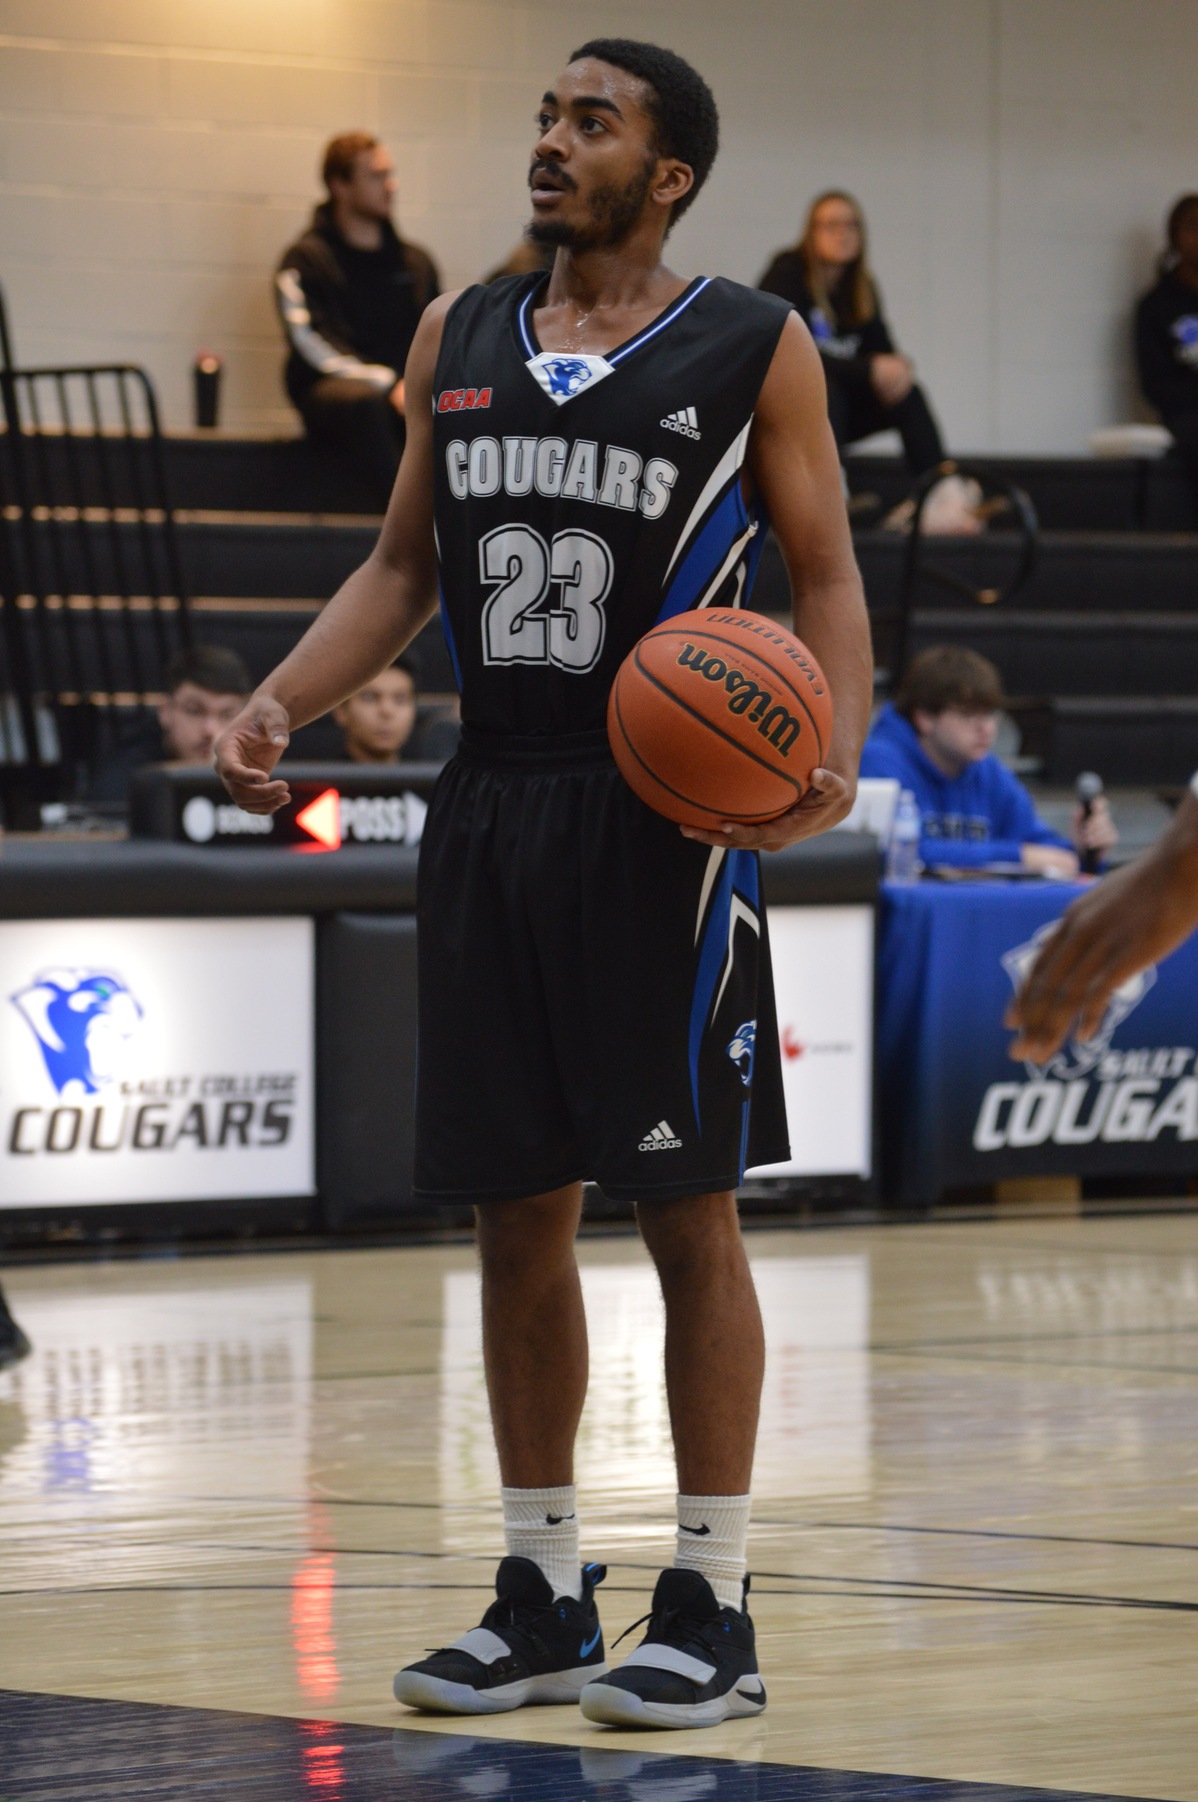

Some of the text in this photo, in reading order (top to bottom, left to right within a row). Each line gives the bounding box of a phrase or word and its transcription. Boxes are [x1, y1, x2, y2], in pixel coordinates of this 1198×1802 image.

[437, 386, 493, 414] OCAA
[659, 418, 702, 441] adidas
[445, 435, 679, 520] COUGARS
[477, 522, 615, 675] 23
[676, 642, 801, 758] Wilson
[8, 1099, 294, 1156] COUGARS
[637, 1137, 683, 1152] adidas
